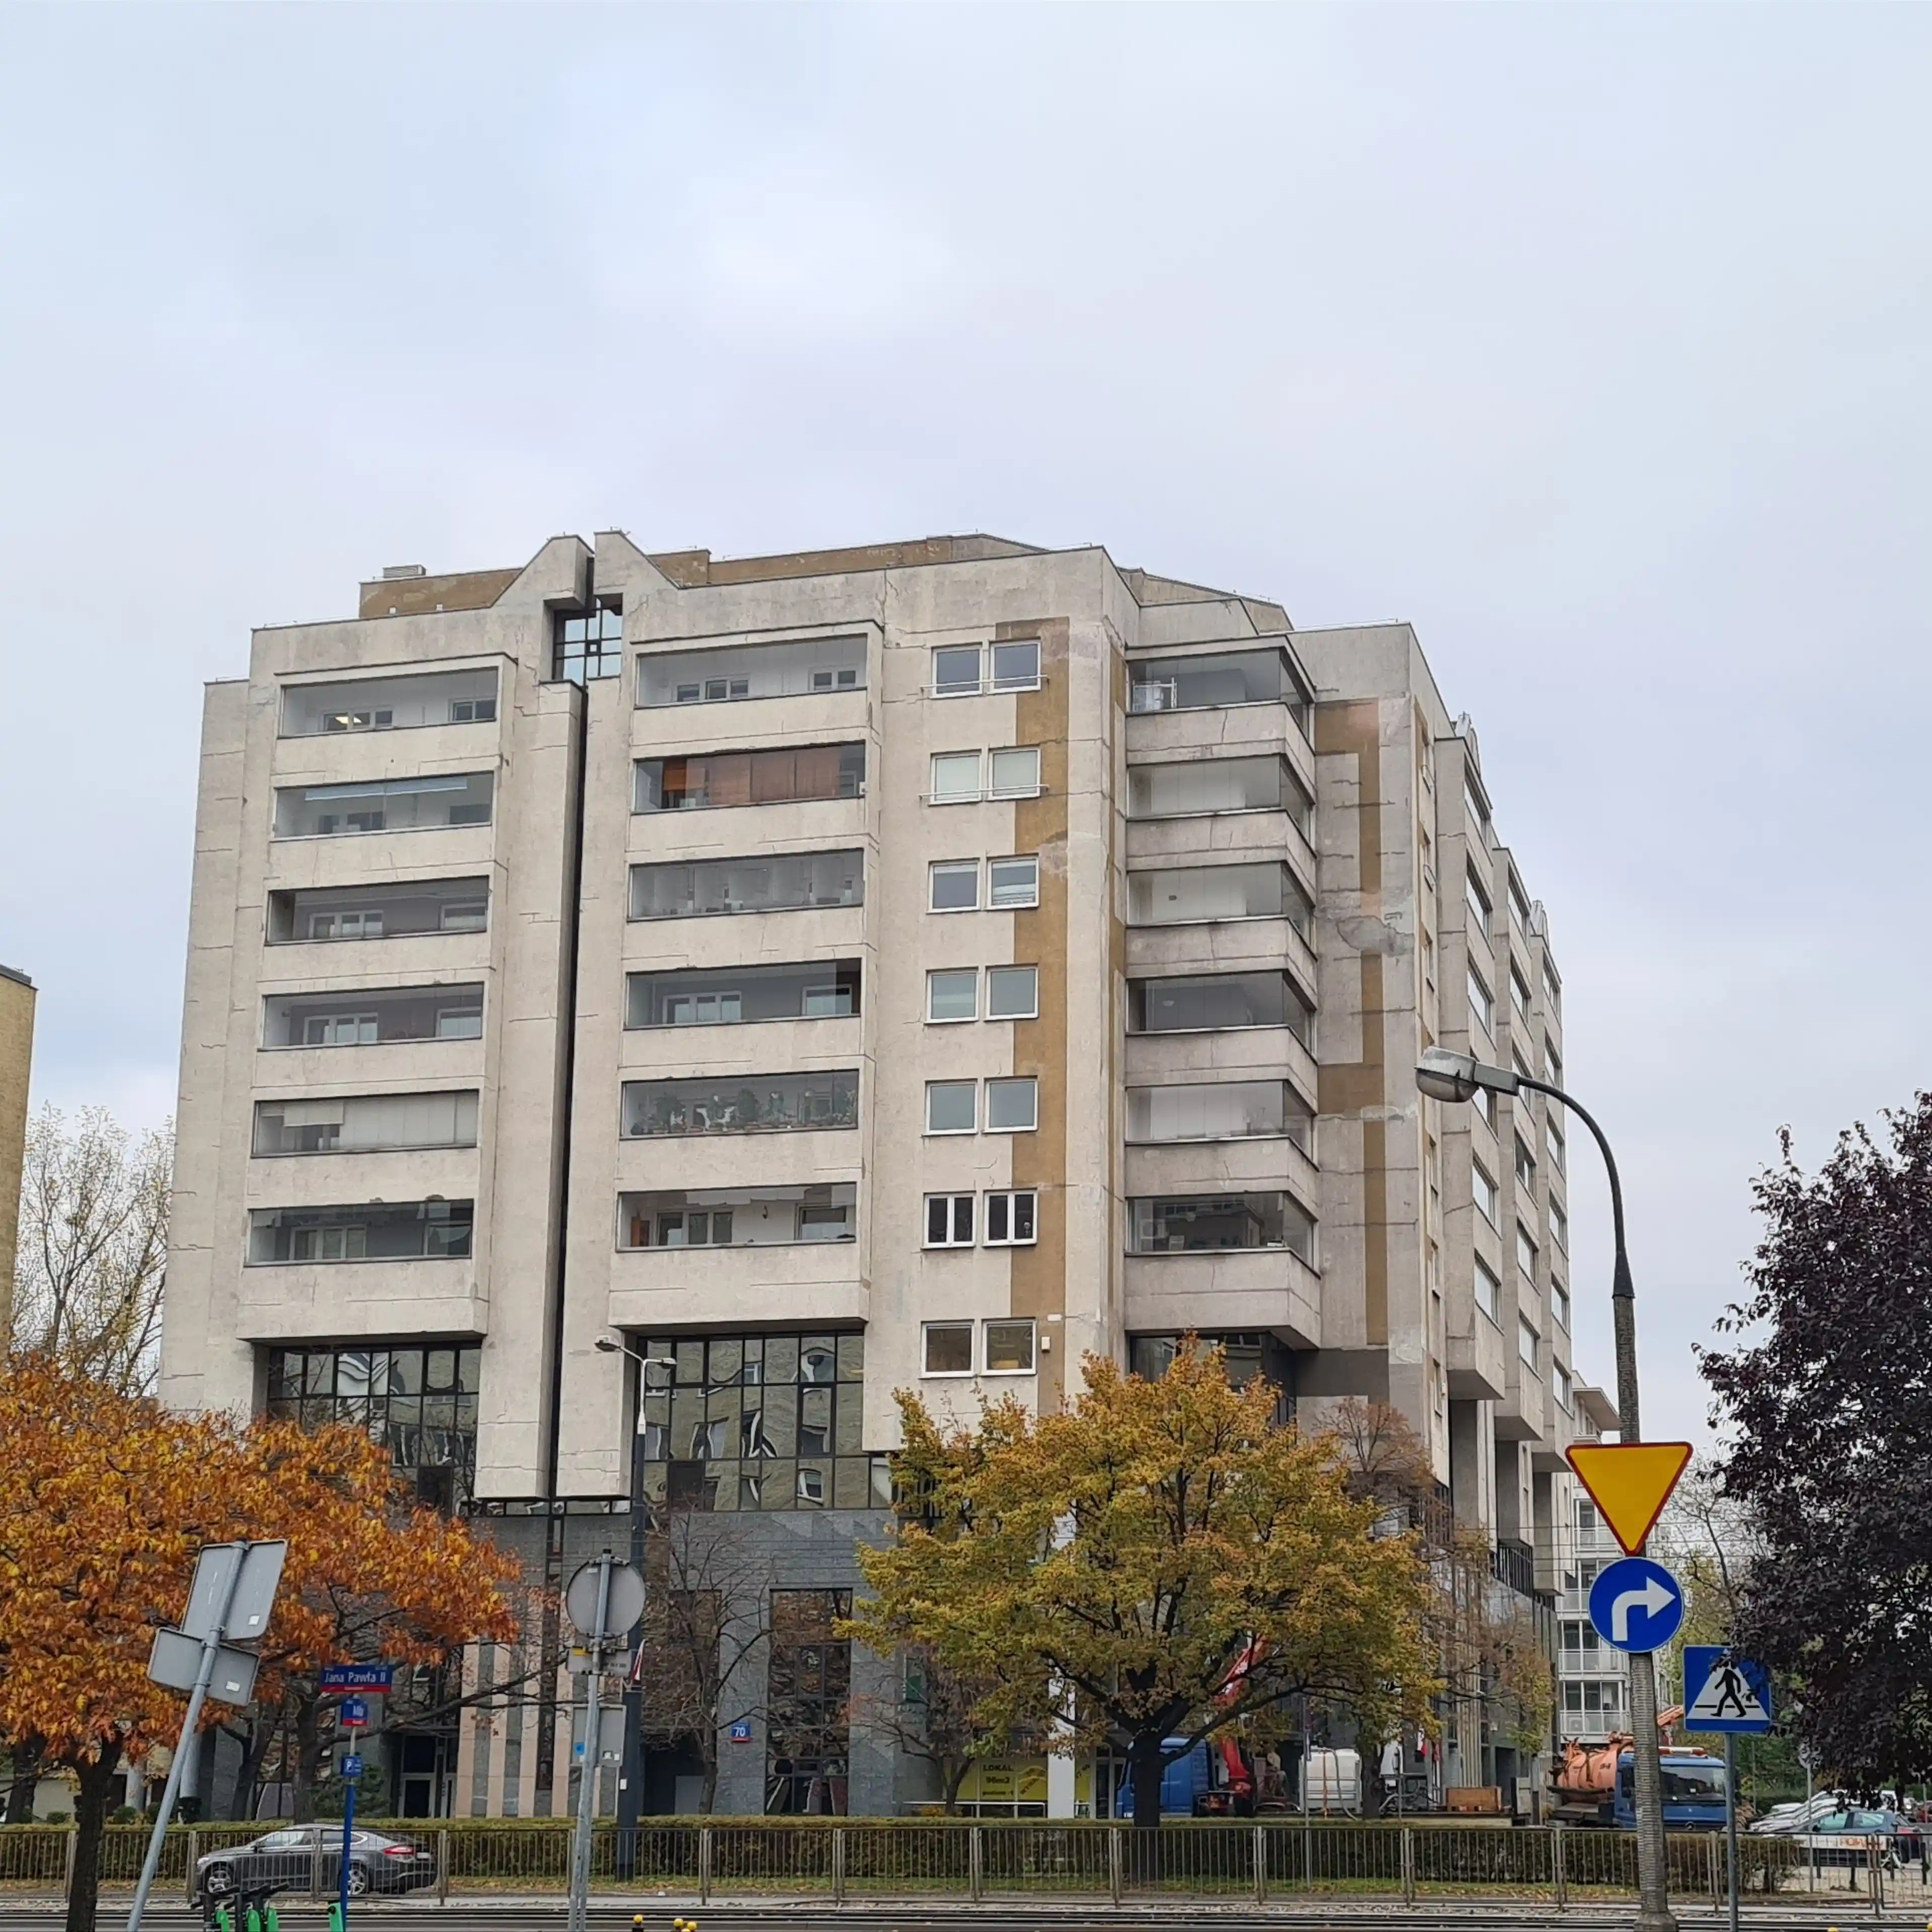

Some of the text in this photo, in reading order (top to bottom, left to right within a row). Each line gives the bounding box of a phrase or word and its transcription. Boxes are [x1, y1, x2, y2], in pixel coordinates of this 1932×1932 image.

[325, 1671, 386, 1683] Jana Pawła II
[733, 1727, 746, 1737] 70
